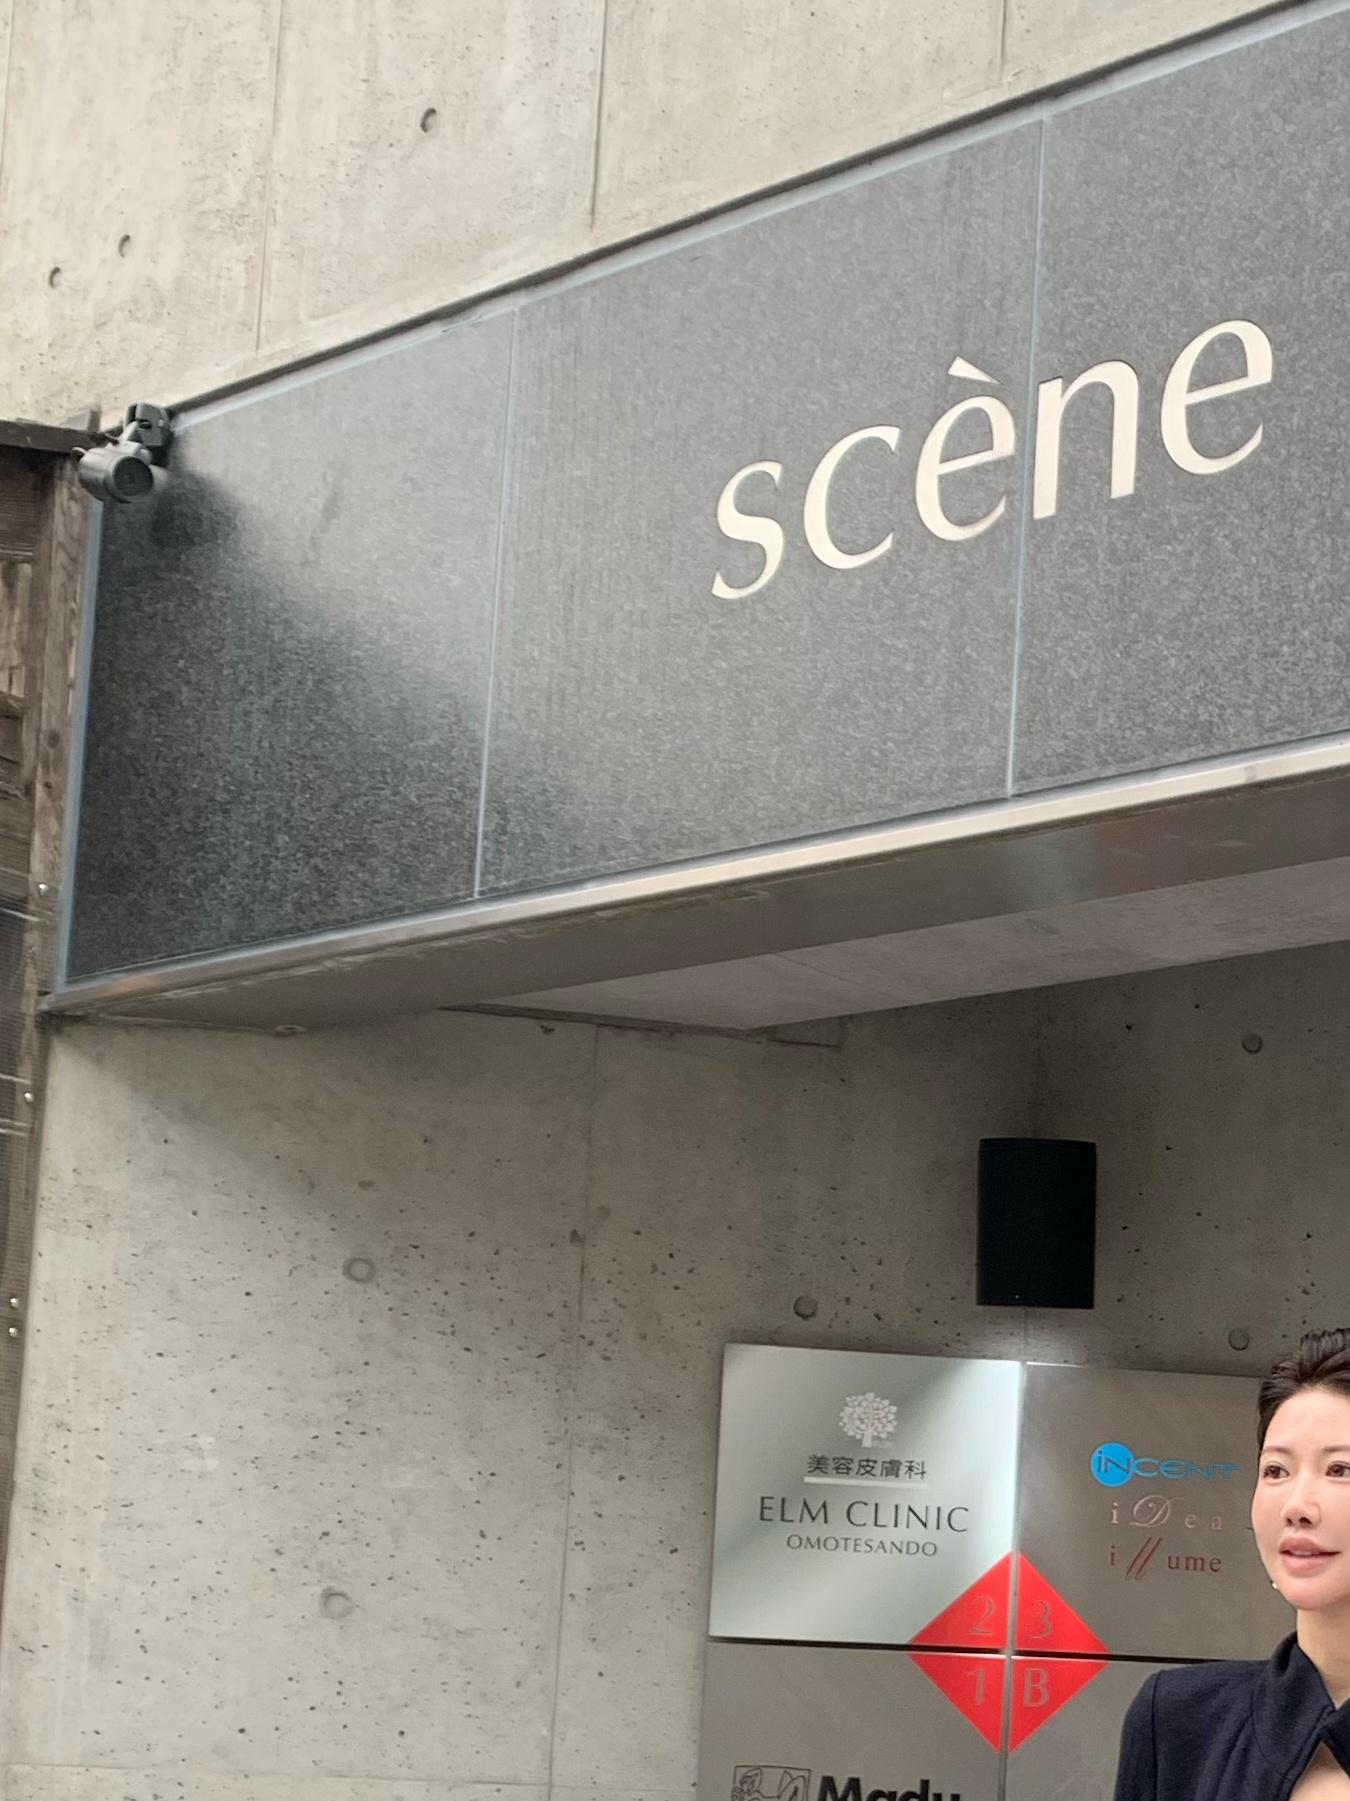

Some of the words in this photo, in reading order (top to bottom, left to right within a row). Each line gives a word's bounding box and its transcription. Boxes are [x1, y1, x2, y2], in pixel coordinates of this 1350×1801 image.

[711, 318, 1275, 601] scène
[807, 1454, 927, 1480] 美容皮膚科
[759, 1495, 829, 1525] ELM
[845, 1500, 970, 1533] CLINIC
[786, 1533, 938, 1557] OMOTESANDO
[968, 1594, 996, 1637] 2
[1030, 1600, 1054, 1641] 3
[966, 1666, 988, 1707] 1
[1021, 1667, 1050, 1709] B
